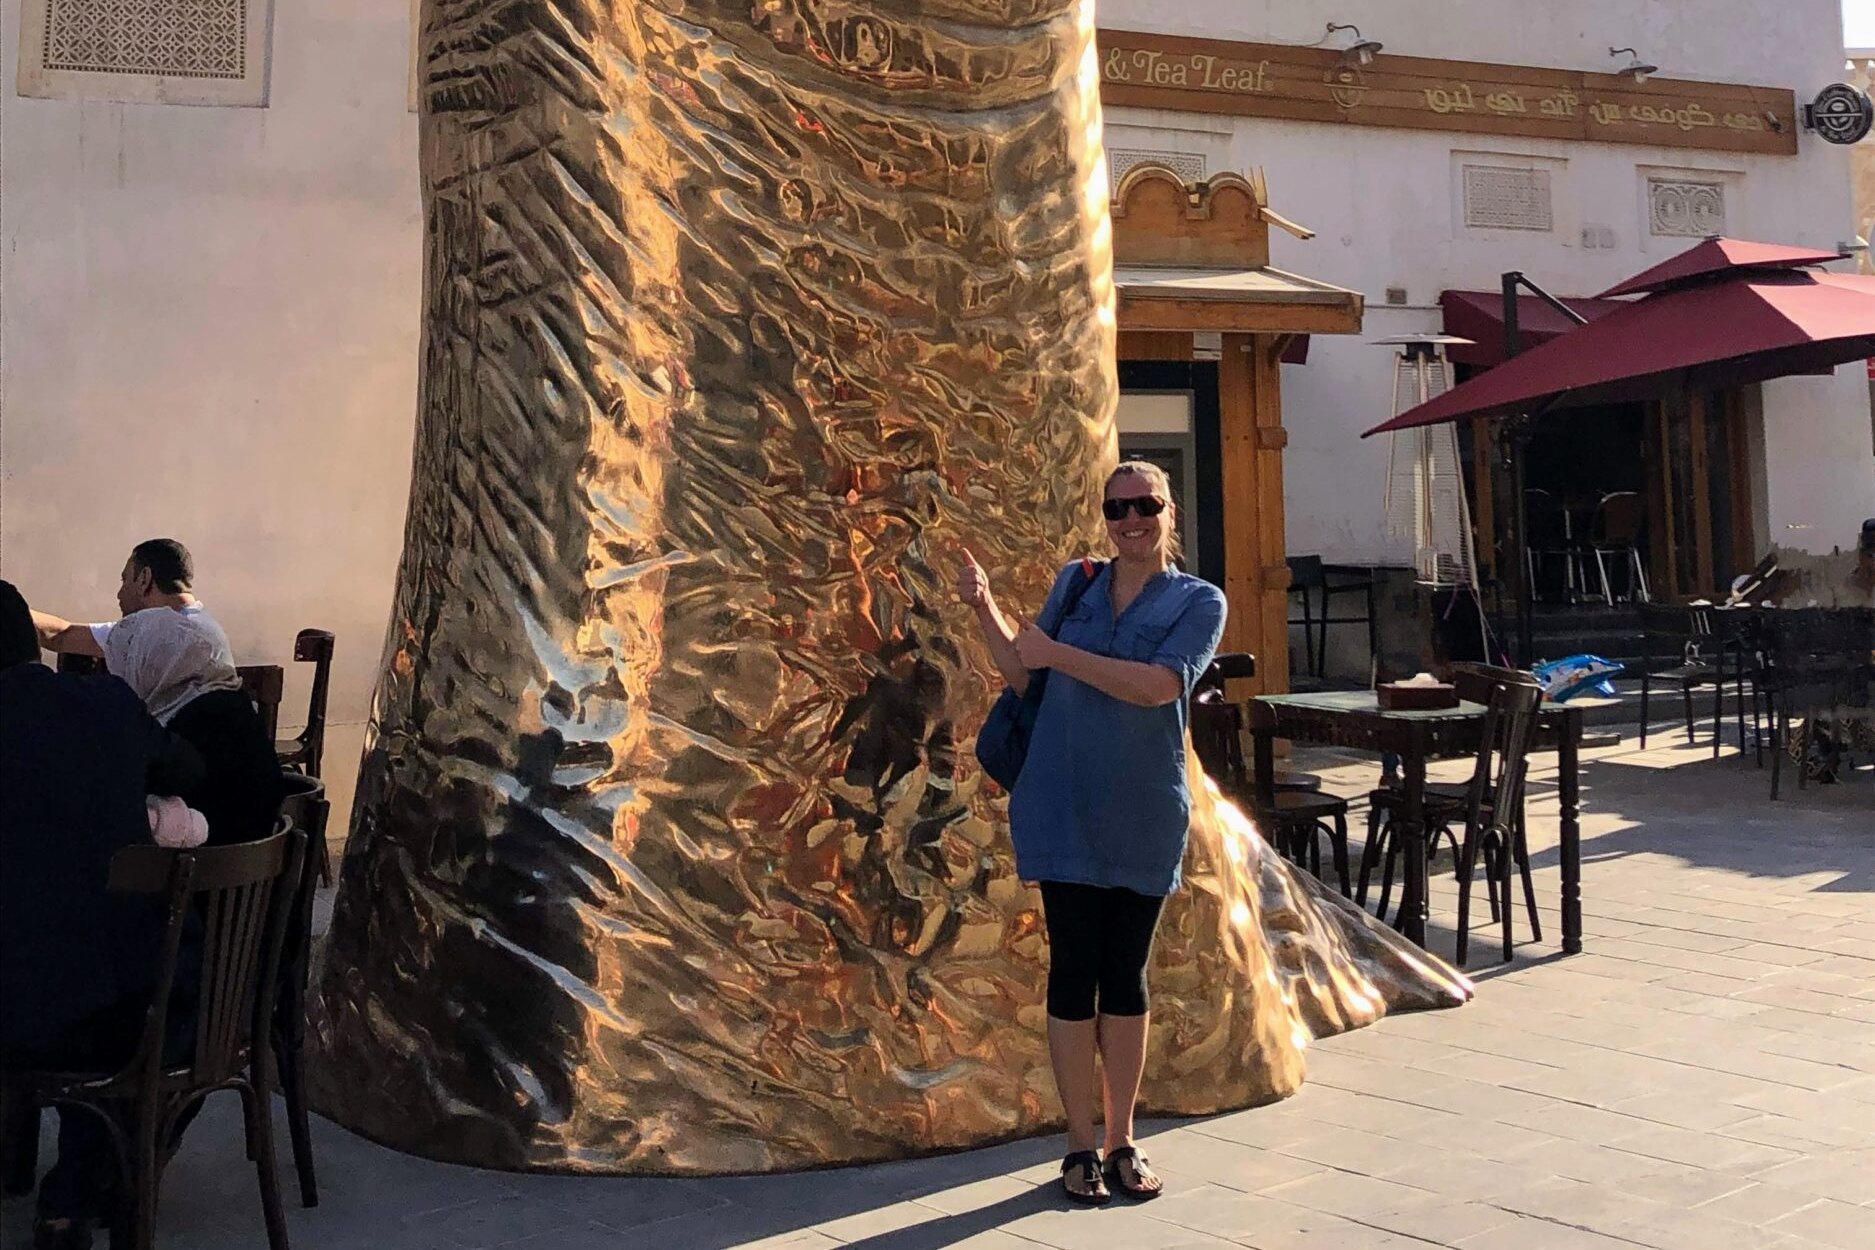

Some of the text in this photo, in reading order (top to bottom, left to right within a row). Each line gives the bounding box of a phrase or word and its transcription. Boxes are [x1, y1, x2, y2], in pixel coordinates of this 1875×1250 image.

[1104, 47, 1270, 92] & Tea Leaf
[1630, 103, 1714, 131] كوفي
